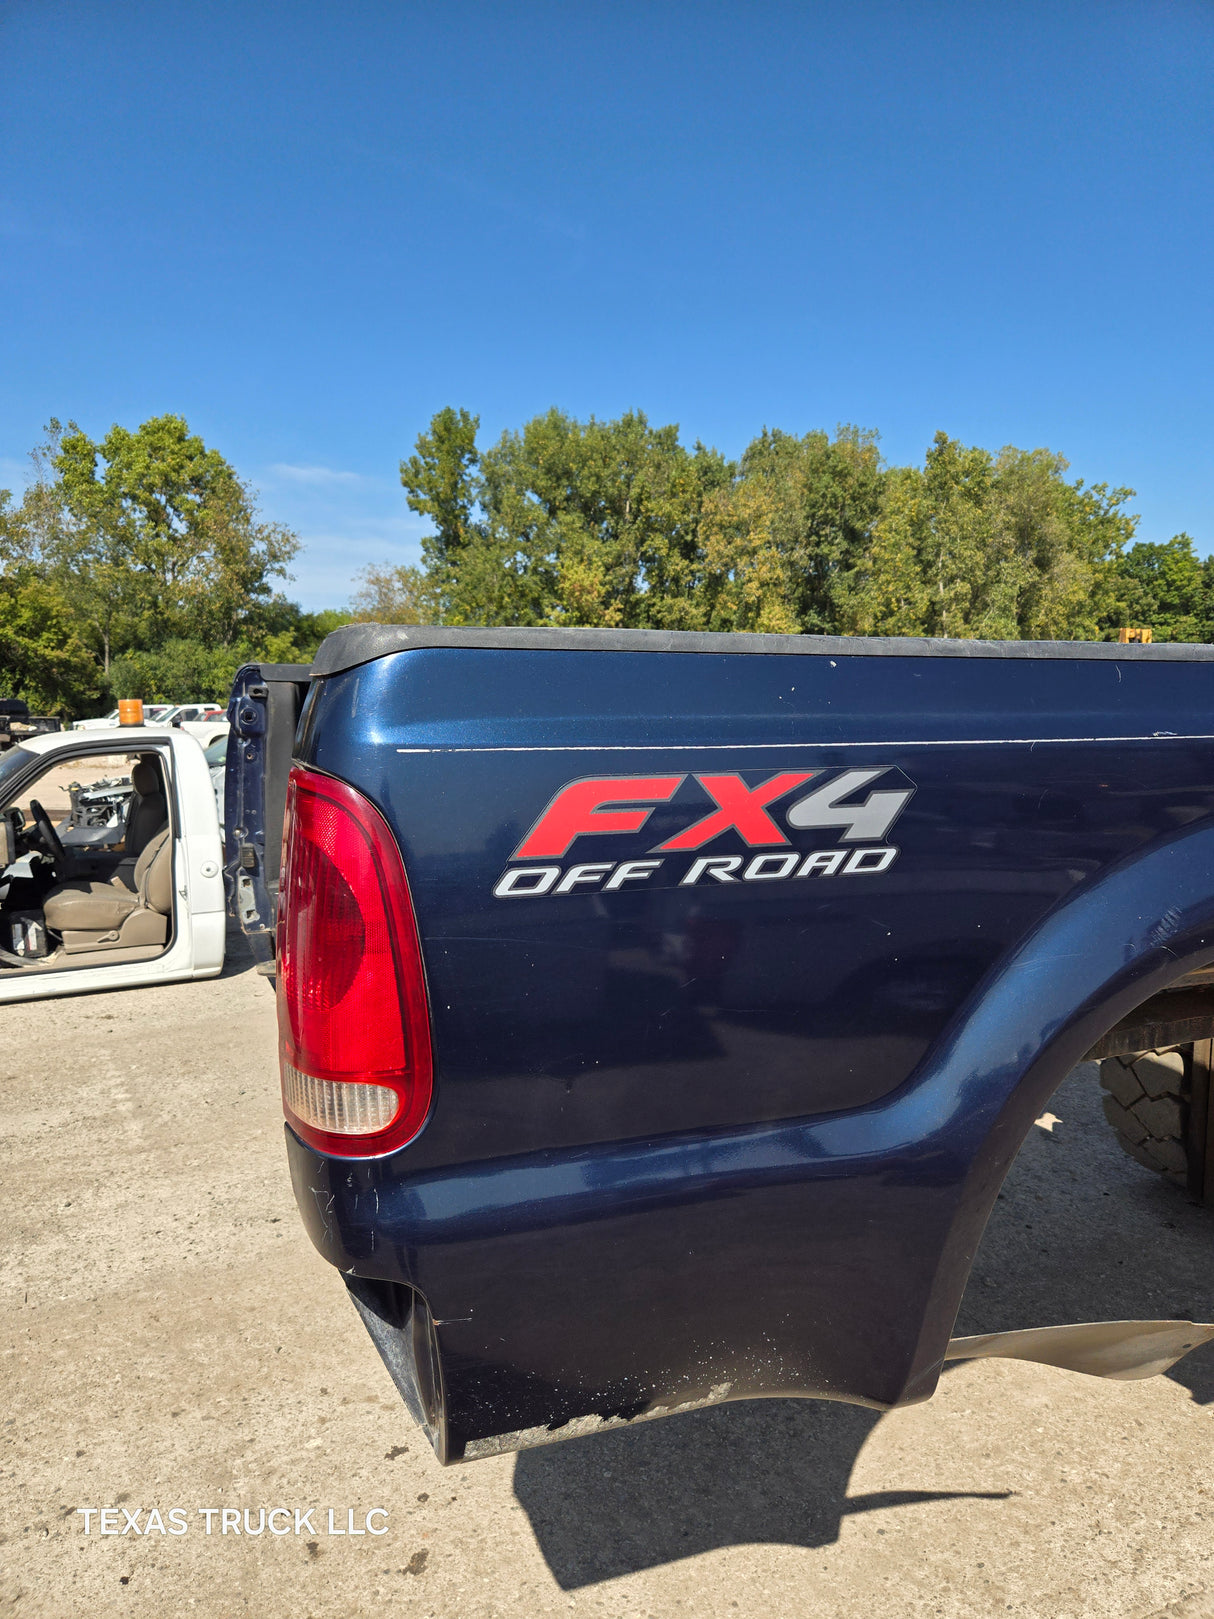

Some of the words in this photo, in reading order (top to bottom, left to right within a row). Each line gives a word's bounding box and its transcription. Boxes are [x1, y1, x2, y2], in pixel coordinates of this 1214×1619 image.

[508, 766, 916, 861] FX4
[493, 858, 666, 897] OFF
[678, 846, 899, 886] ROAD
